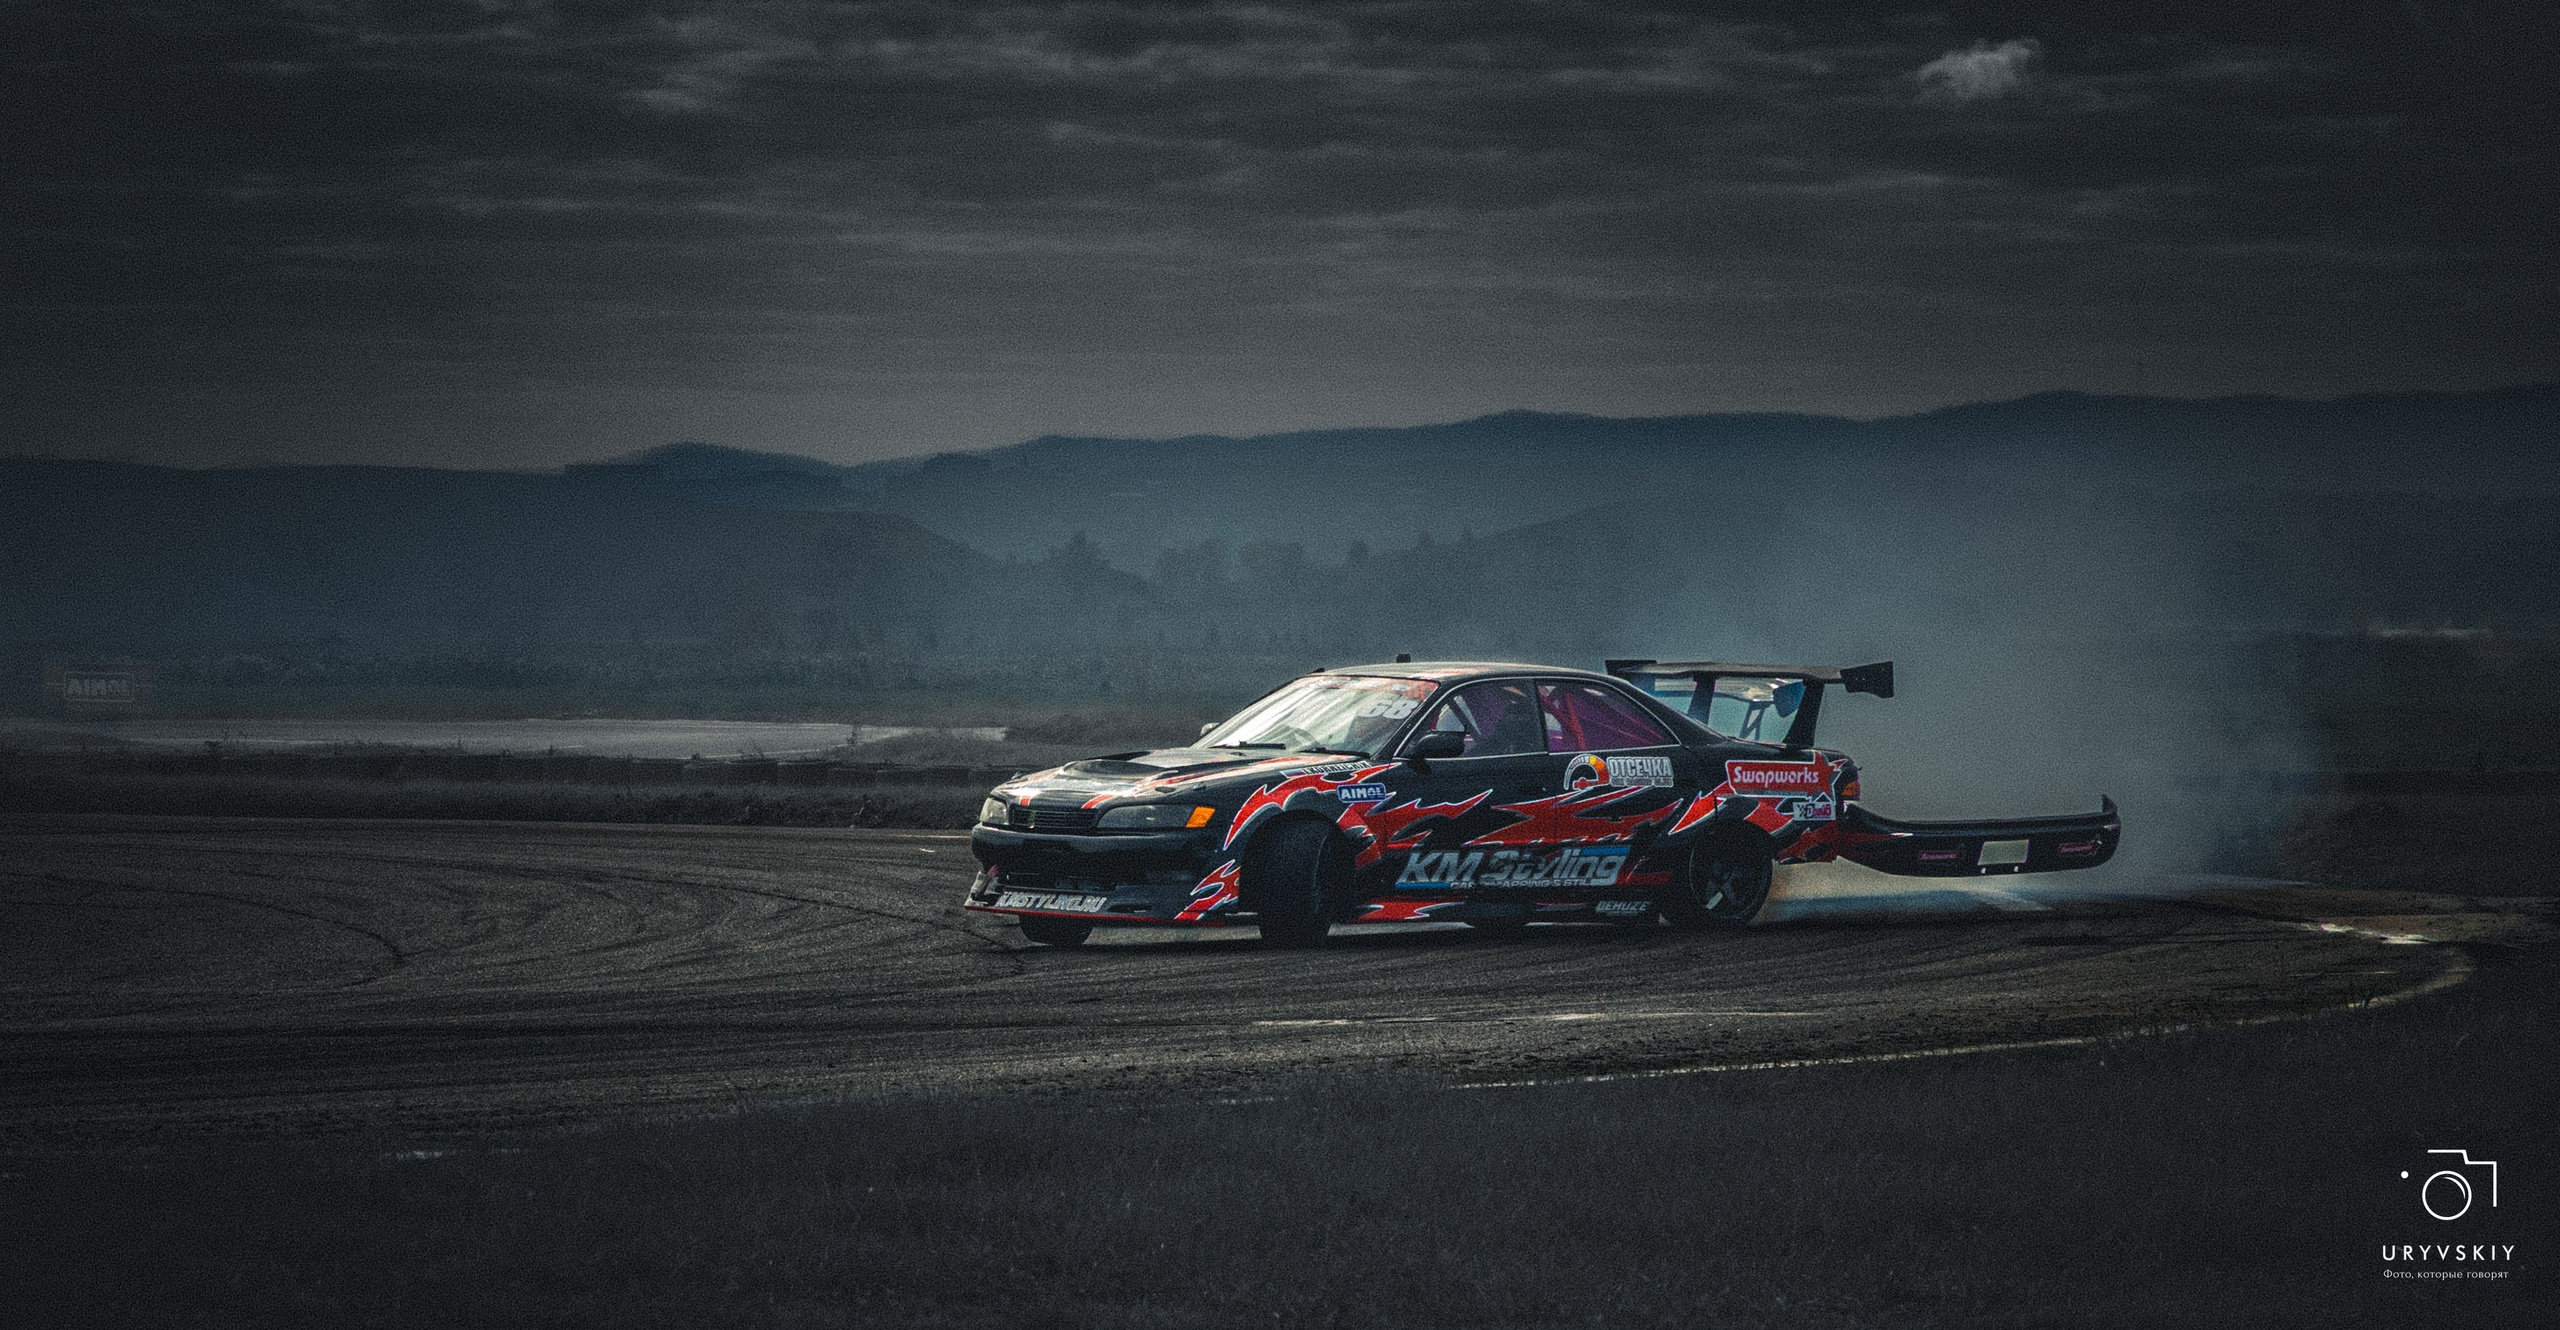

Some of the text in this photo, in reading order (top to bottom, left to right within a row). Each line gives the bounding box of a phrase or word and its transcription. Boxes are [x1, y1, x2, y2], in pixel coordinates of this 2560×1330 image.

[1358, 699, 1419, 720] 68
[1609, 758, 1672, 778] ОТСЕЧКА
[1733, 765, 1820, 788] Swapworks
[1341, 786, 1384, 800] AIMOL
[1397, 847, 1627, 886] KM Styling
